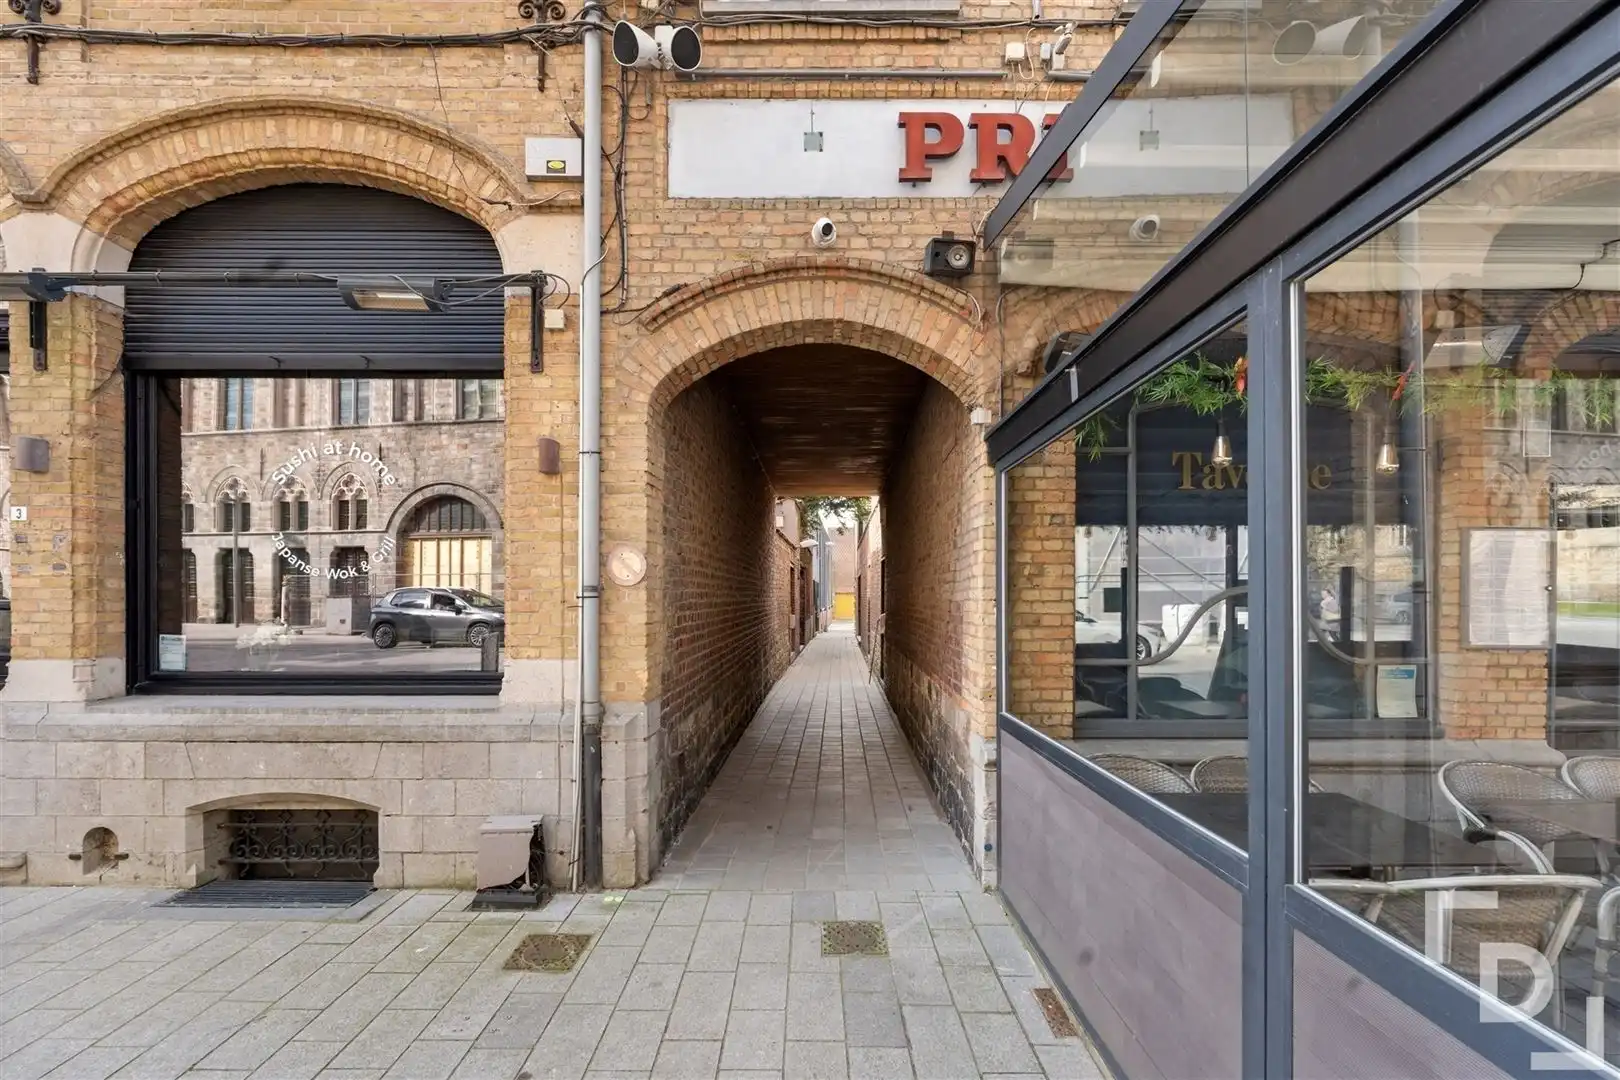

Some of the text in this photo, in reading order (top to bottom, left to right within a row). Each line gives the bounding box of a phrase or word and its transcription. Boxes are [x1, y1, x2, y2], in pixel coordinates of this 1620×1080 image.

[898, 112, 1070, 183] PR
[271, 440, 396, 486] Sushi at home
[1172, 450, 1333, 490] Tave
[15, 508, 22, 519] 3
[271, 531, 396, 580] Japanse Wok & Grill
